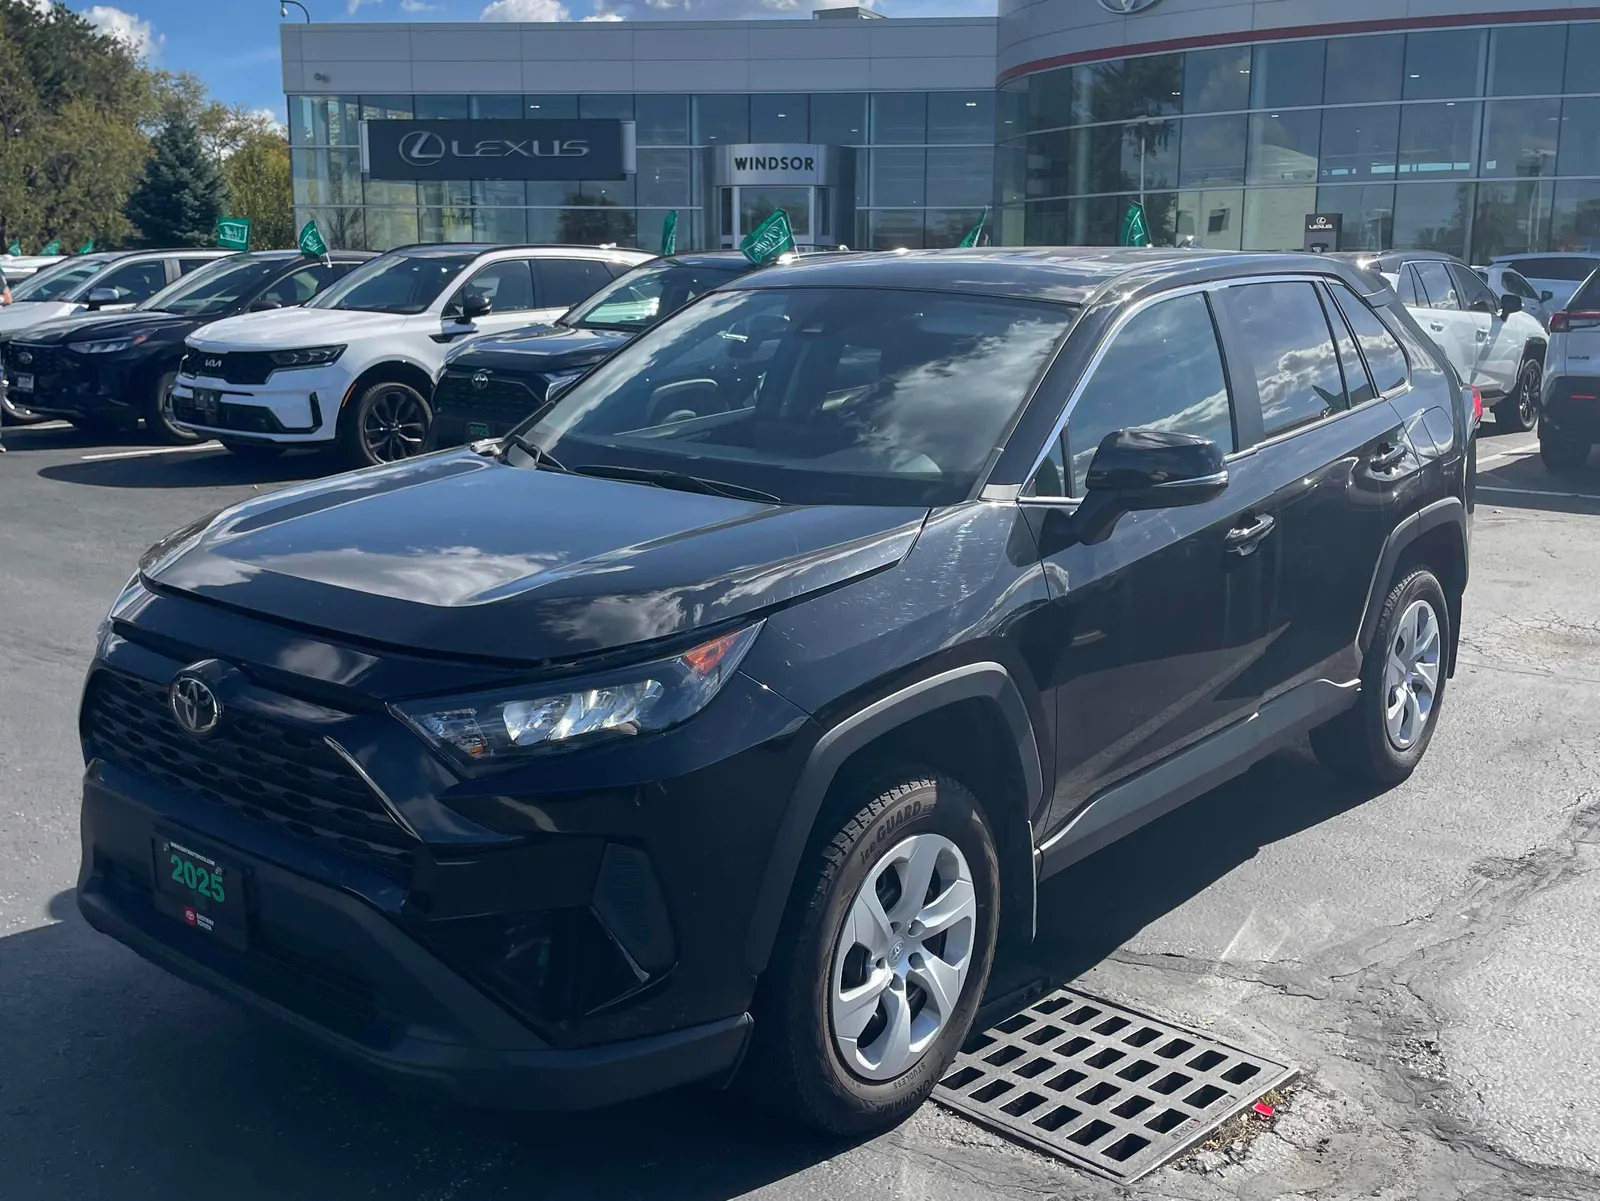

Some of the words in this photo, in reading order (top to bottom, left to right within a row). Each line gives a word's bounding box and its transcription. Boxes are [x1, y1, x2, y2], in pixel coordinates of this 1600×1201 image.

[452, 140, 590, 157] LEXUS
[734, 156, 815, 171] WINDSOR
[205, 358, 222, 368] KIA
[877, 800, 921, 841] GUARD
[170, 854, 225, 902] 2025
[893, 1062, 926, 1090] STUDLESS
